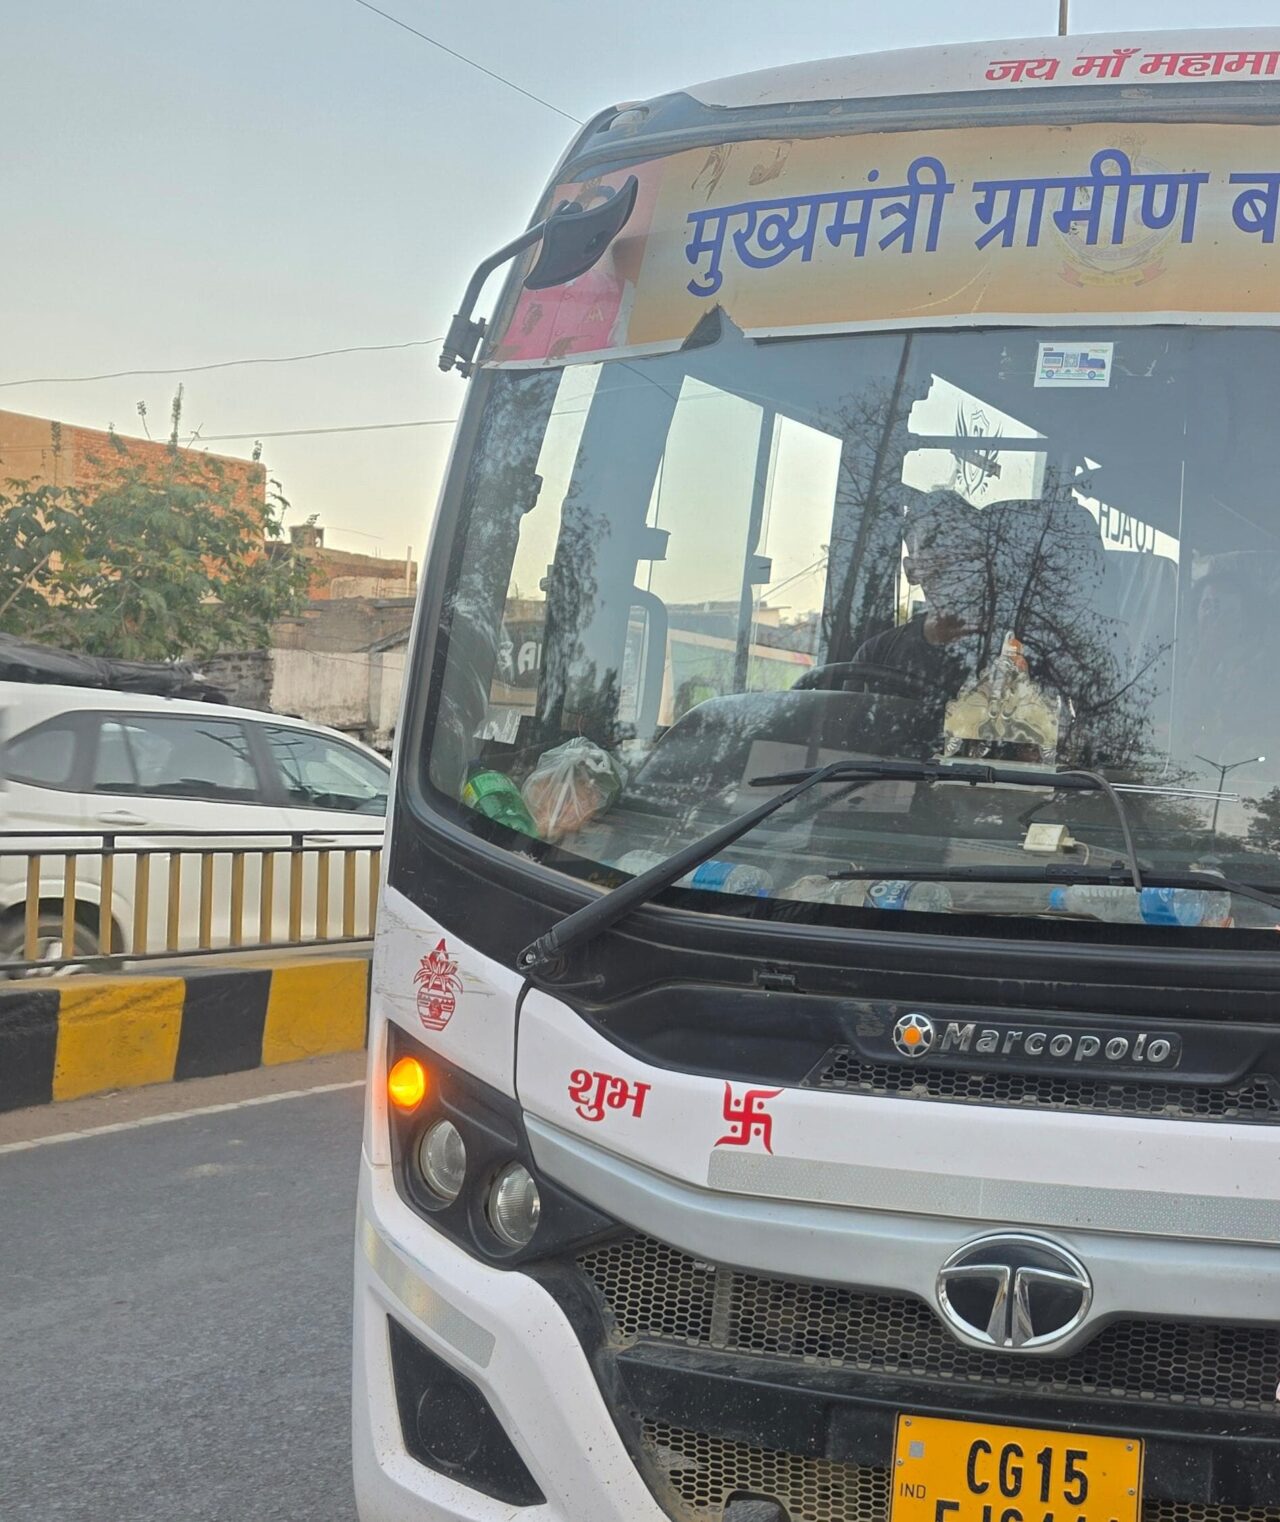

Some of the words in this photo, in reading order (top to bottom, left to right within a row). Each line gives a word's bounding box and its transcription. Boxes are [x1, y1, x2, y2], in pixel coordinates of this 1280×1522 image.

[985, 58, 1060, 82] जय
[1072, 48, 1142, 78] माँ
[685, 155, 955, 297] मुख्यमंत्री
[973, 148, 1210, 247] ग्रामीण
[940, 1021, 1172, 1062] Marcopolo
[567, 1068, 652, 1122] शुभ
[900, 1483, 926, 1499] IND
[966, 1438, 1089, 1506] CG15
